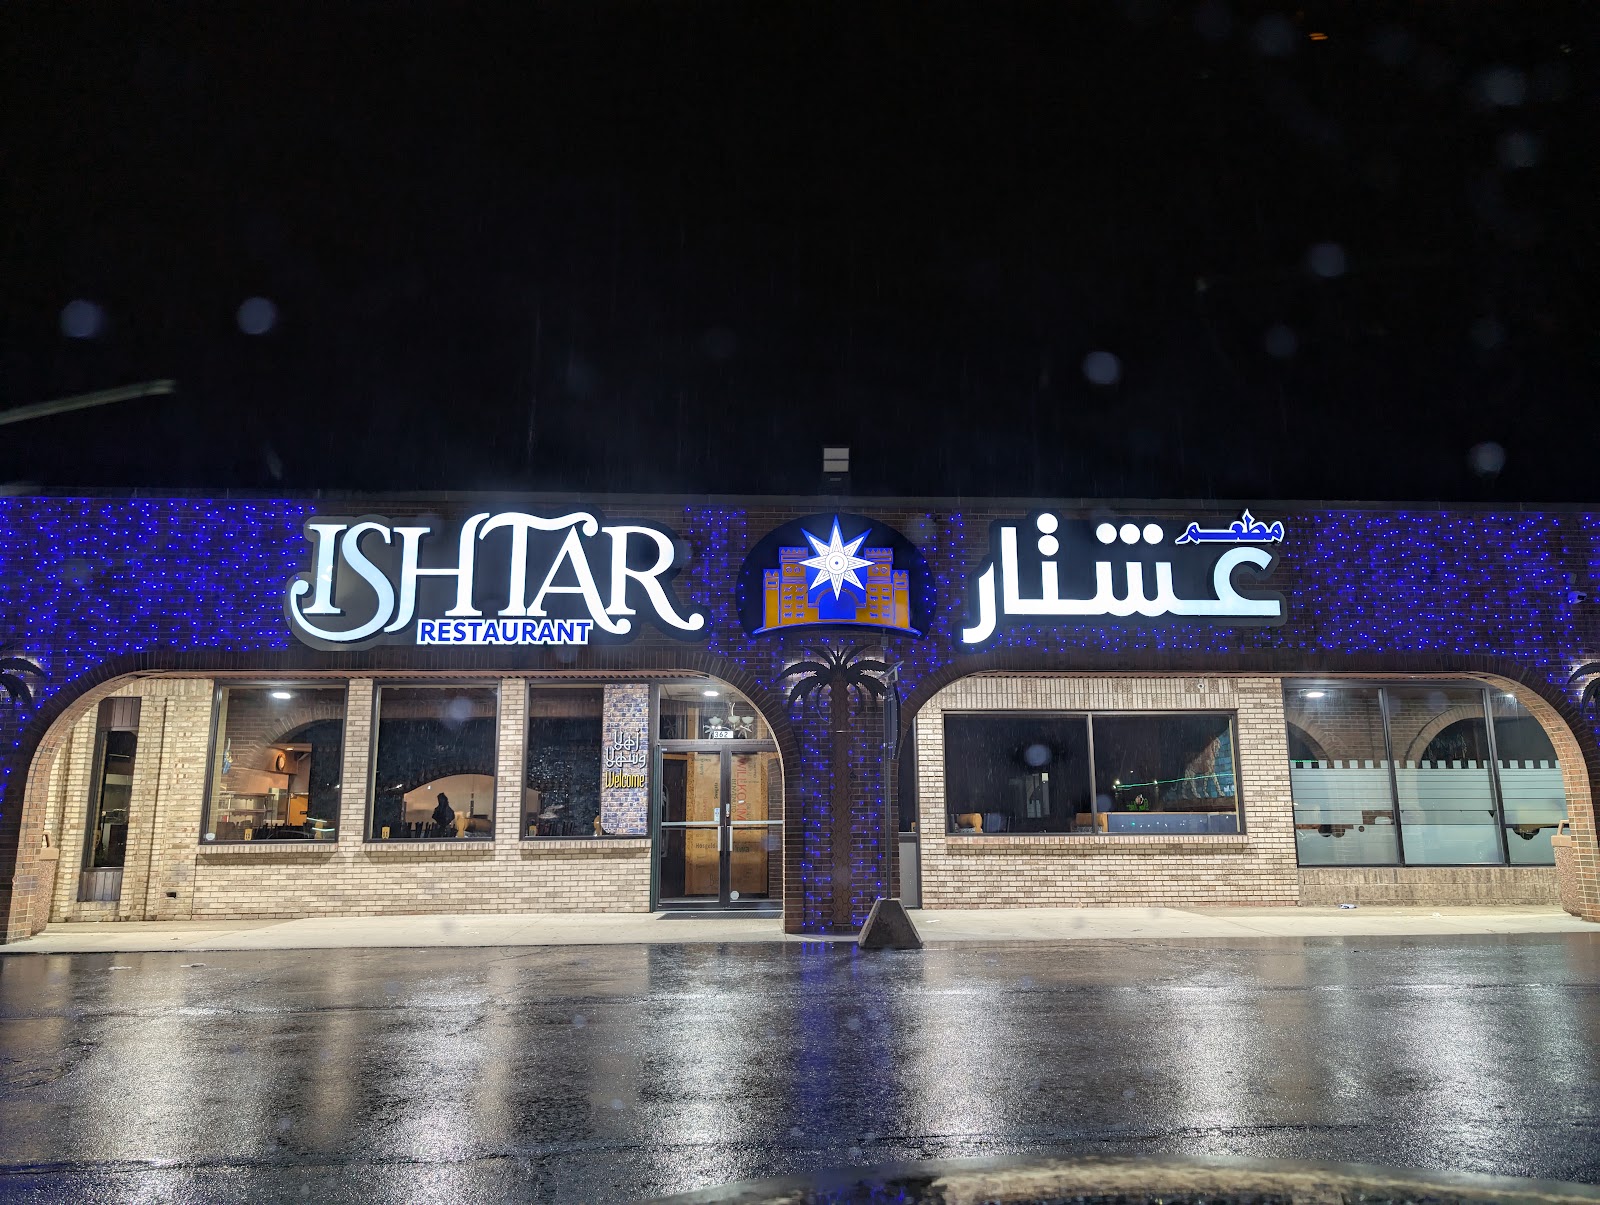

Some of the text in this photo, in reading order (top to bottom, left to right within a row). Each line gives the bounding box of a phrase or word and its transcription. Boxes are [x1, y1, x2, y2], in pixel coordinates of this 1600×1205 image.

[1175, 509, 1285, 544] مطعم
[289, 511, 705, 642] ISHTAR
[962, 512, 1281, 644] عشتار
[418, 620, 592, 643] RESTAURANT
[605, 769, 645, 788] Welcome
[736, 757, 747, 836] WILLKOMMN
